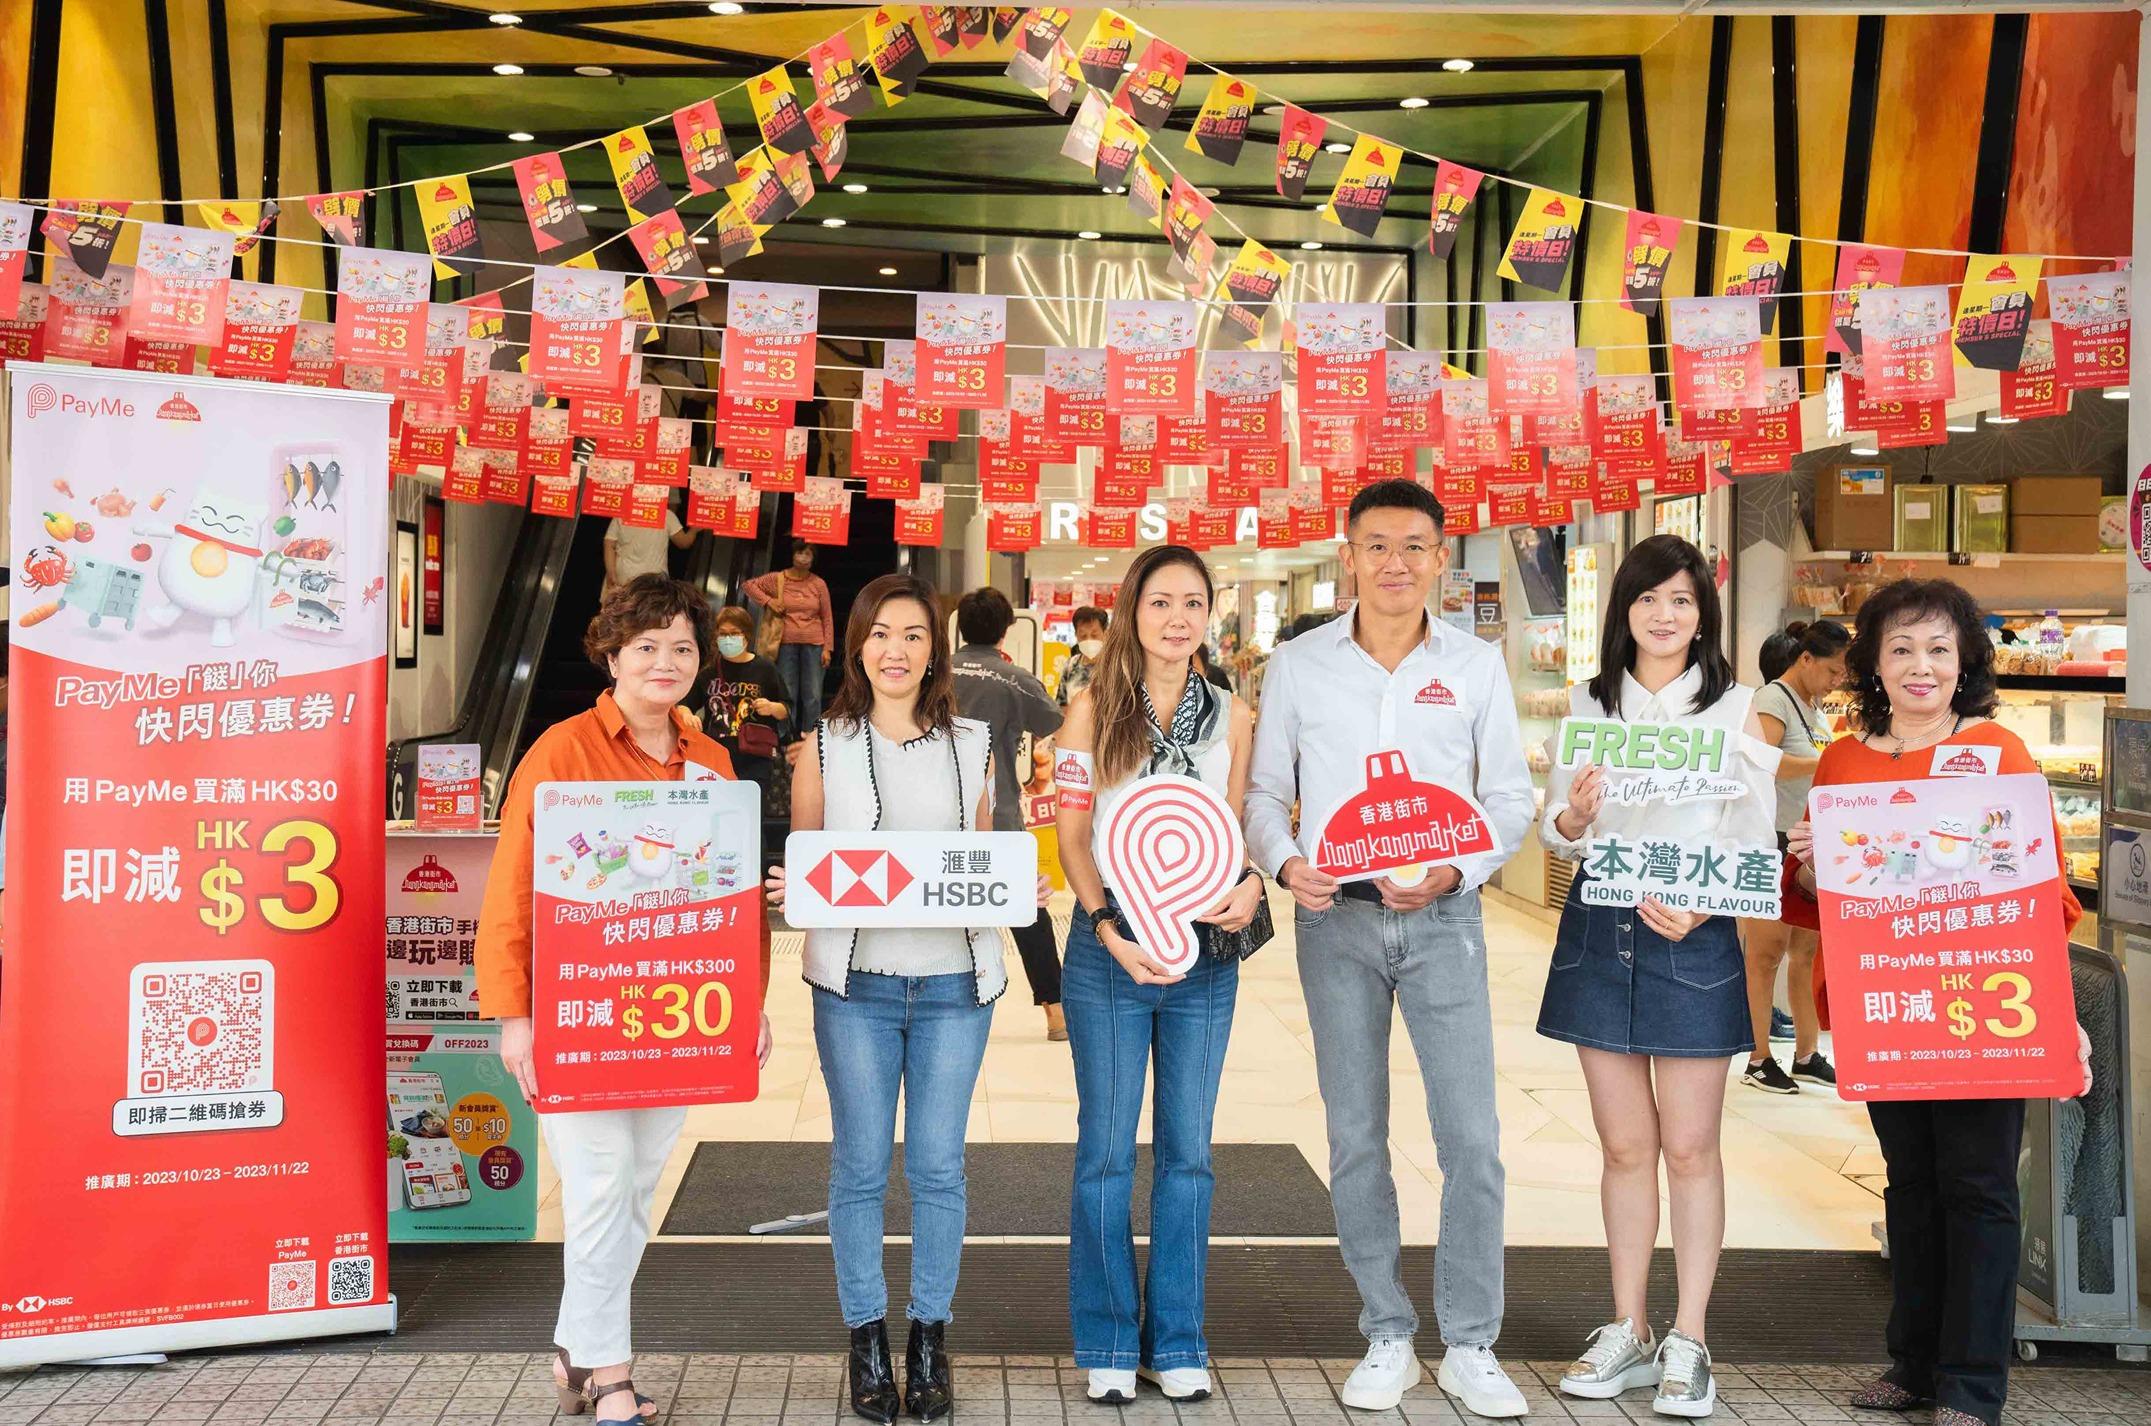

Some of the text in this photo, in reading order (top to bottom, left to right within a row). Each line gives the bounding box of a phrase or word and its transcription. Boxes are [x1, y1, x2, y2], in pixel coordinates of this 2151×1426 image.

[1990, 292, 2027, 312] 會員
[1958, 310, 2026, 336] 特價日!
[62, 394, 135, 418] PayMe
[55, 673, 180, 709] PayMe
[1561, 721, 1725, 773] FRESH
[96, 779, 187, 807] PayMe
[252, 778, 337, 803] HK$30
[562, 789, 709, 807] PayMe FRESH 本灣水產
[1624, 776, 1690, 801] Ultimate
[1359, 796, 1428, 825] 香港街市
[1836, 796, 1878, 808] PayMe
[61, 847, 181, 903] 即減
[196, 820, 250, 849] HK
[1589, 839, 1777, 894] 本灣水產
[923, 882, 1008, 907] HSBC
[1587, 886, 1633, 902] HONG
[1697, 896, 1775, 915] FLAVOUR
[555, 900, 629, 924] PayMe
[1840, 895, 1917, 919] PayMe
[386, 916, 453, 935] 香港街市
[578, 963, 633, 981] PayMe
[672, 959, 735, 975] HK$300
[1878, 954, 1935, 970] PayMe
[1975, 949, 2033, 965] HK$30
[407, 980, 462, 993] 立即下載
[1864, 989, 1936, 1024] 即減
[1941, 973, 1975, 991] HK
[411, 998, 447, 1007] 香港街市
[557, 999, 613, 1028] 即減
[621, 985, 645, 999] HK
[445, 1039, 489, 1048] OFF2023
[127, 1101, 266, 1125] 即掃二維碼搶券
[453, 1118, 472, 1133] 50
[491, 1166, 509, 1180] 50
[275, 1237, 310, 1248] 立即下載
[335, 1232, 368, 1243] 立即下載
[278, 1249, 307, 1260] PayMe
[2, 1297, 73, 1312] By HSBC
